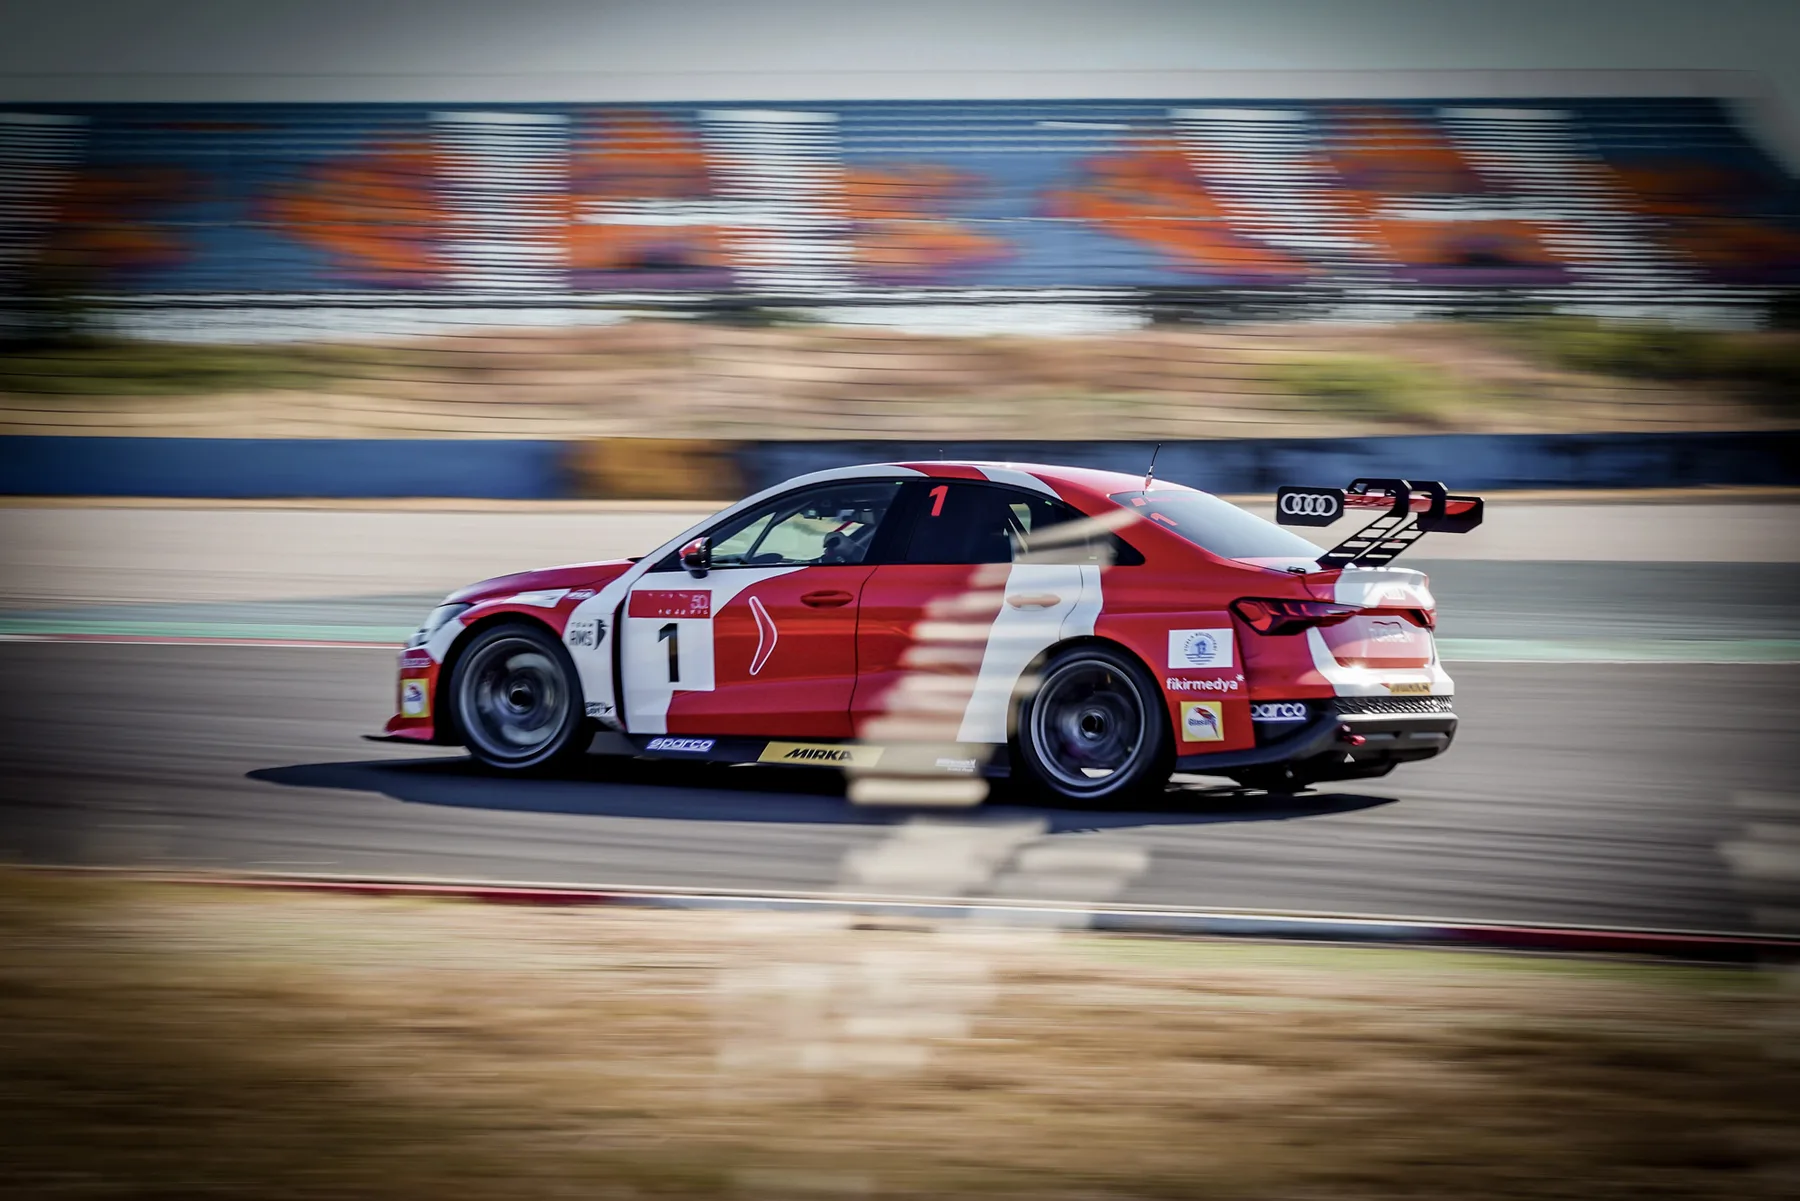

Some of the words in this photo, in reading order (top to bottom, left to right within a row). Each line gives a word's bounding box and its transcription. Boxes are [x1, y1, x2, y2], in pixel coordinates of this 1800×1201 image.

[929, 485, 949, 517] 1
[657, 622, 680, 683] 1
[1166, 676, 1239, 693] fikirmedya
[646, 738, 714, 751] sparco
[784, 748, 853, 761] MIRKA
